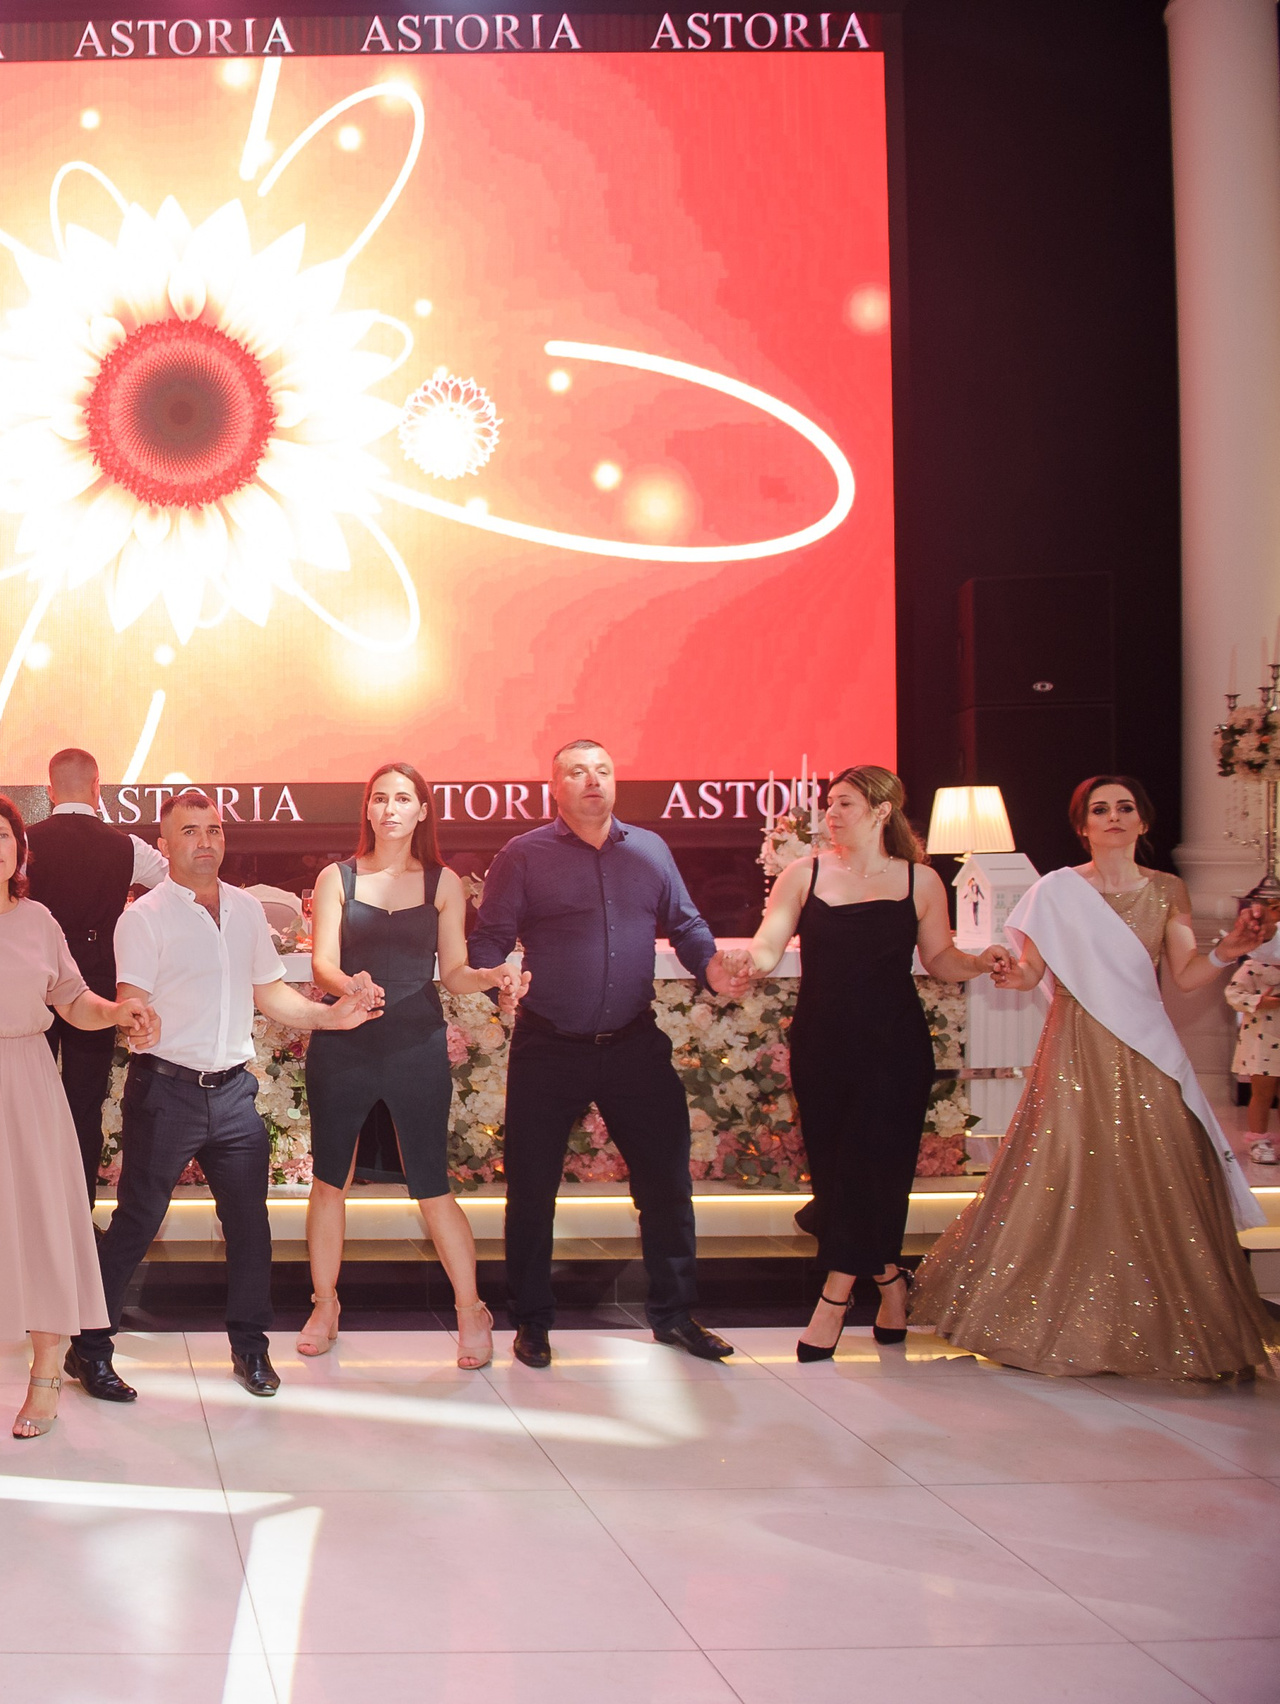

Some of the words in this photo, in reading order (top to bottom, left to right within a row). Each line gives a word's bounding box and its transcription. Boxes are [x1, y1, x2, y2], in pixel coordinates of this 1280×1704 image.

[74, 17, 296, 58] ASTORIA
[360, 13, 583, 53] ASTORIA
[650, 12, 870, 50] ASTORIA
[96, 785, 304, 824] ASTRIA
[433, 783, 555, 821] TORI
